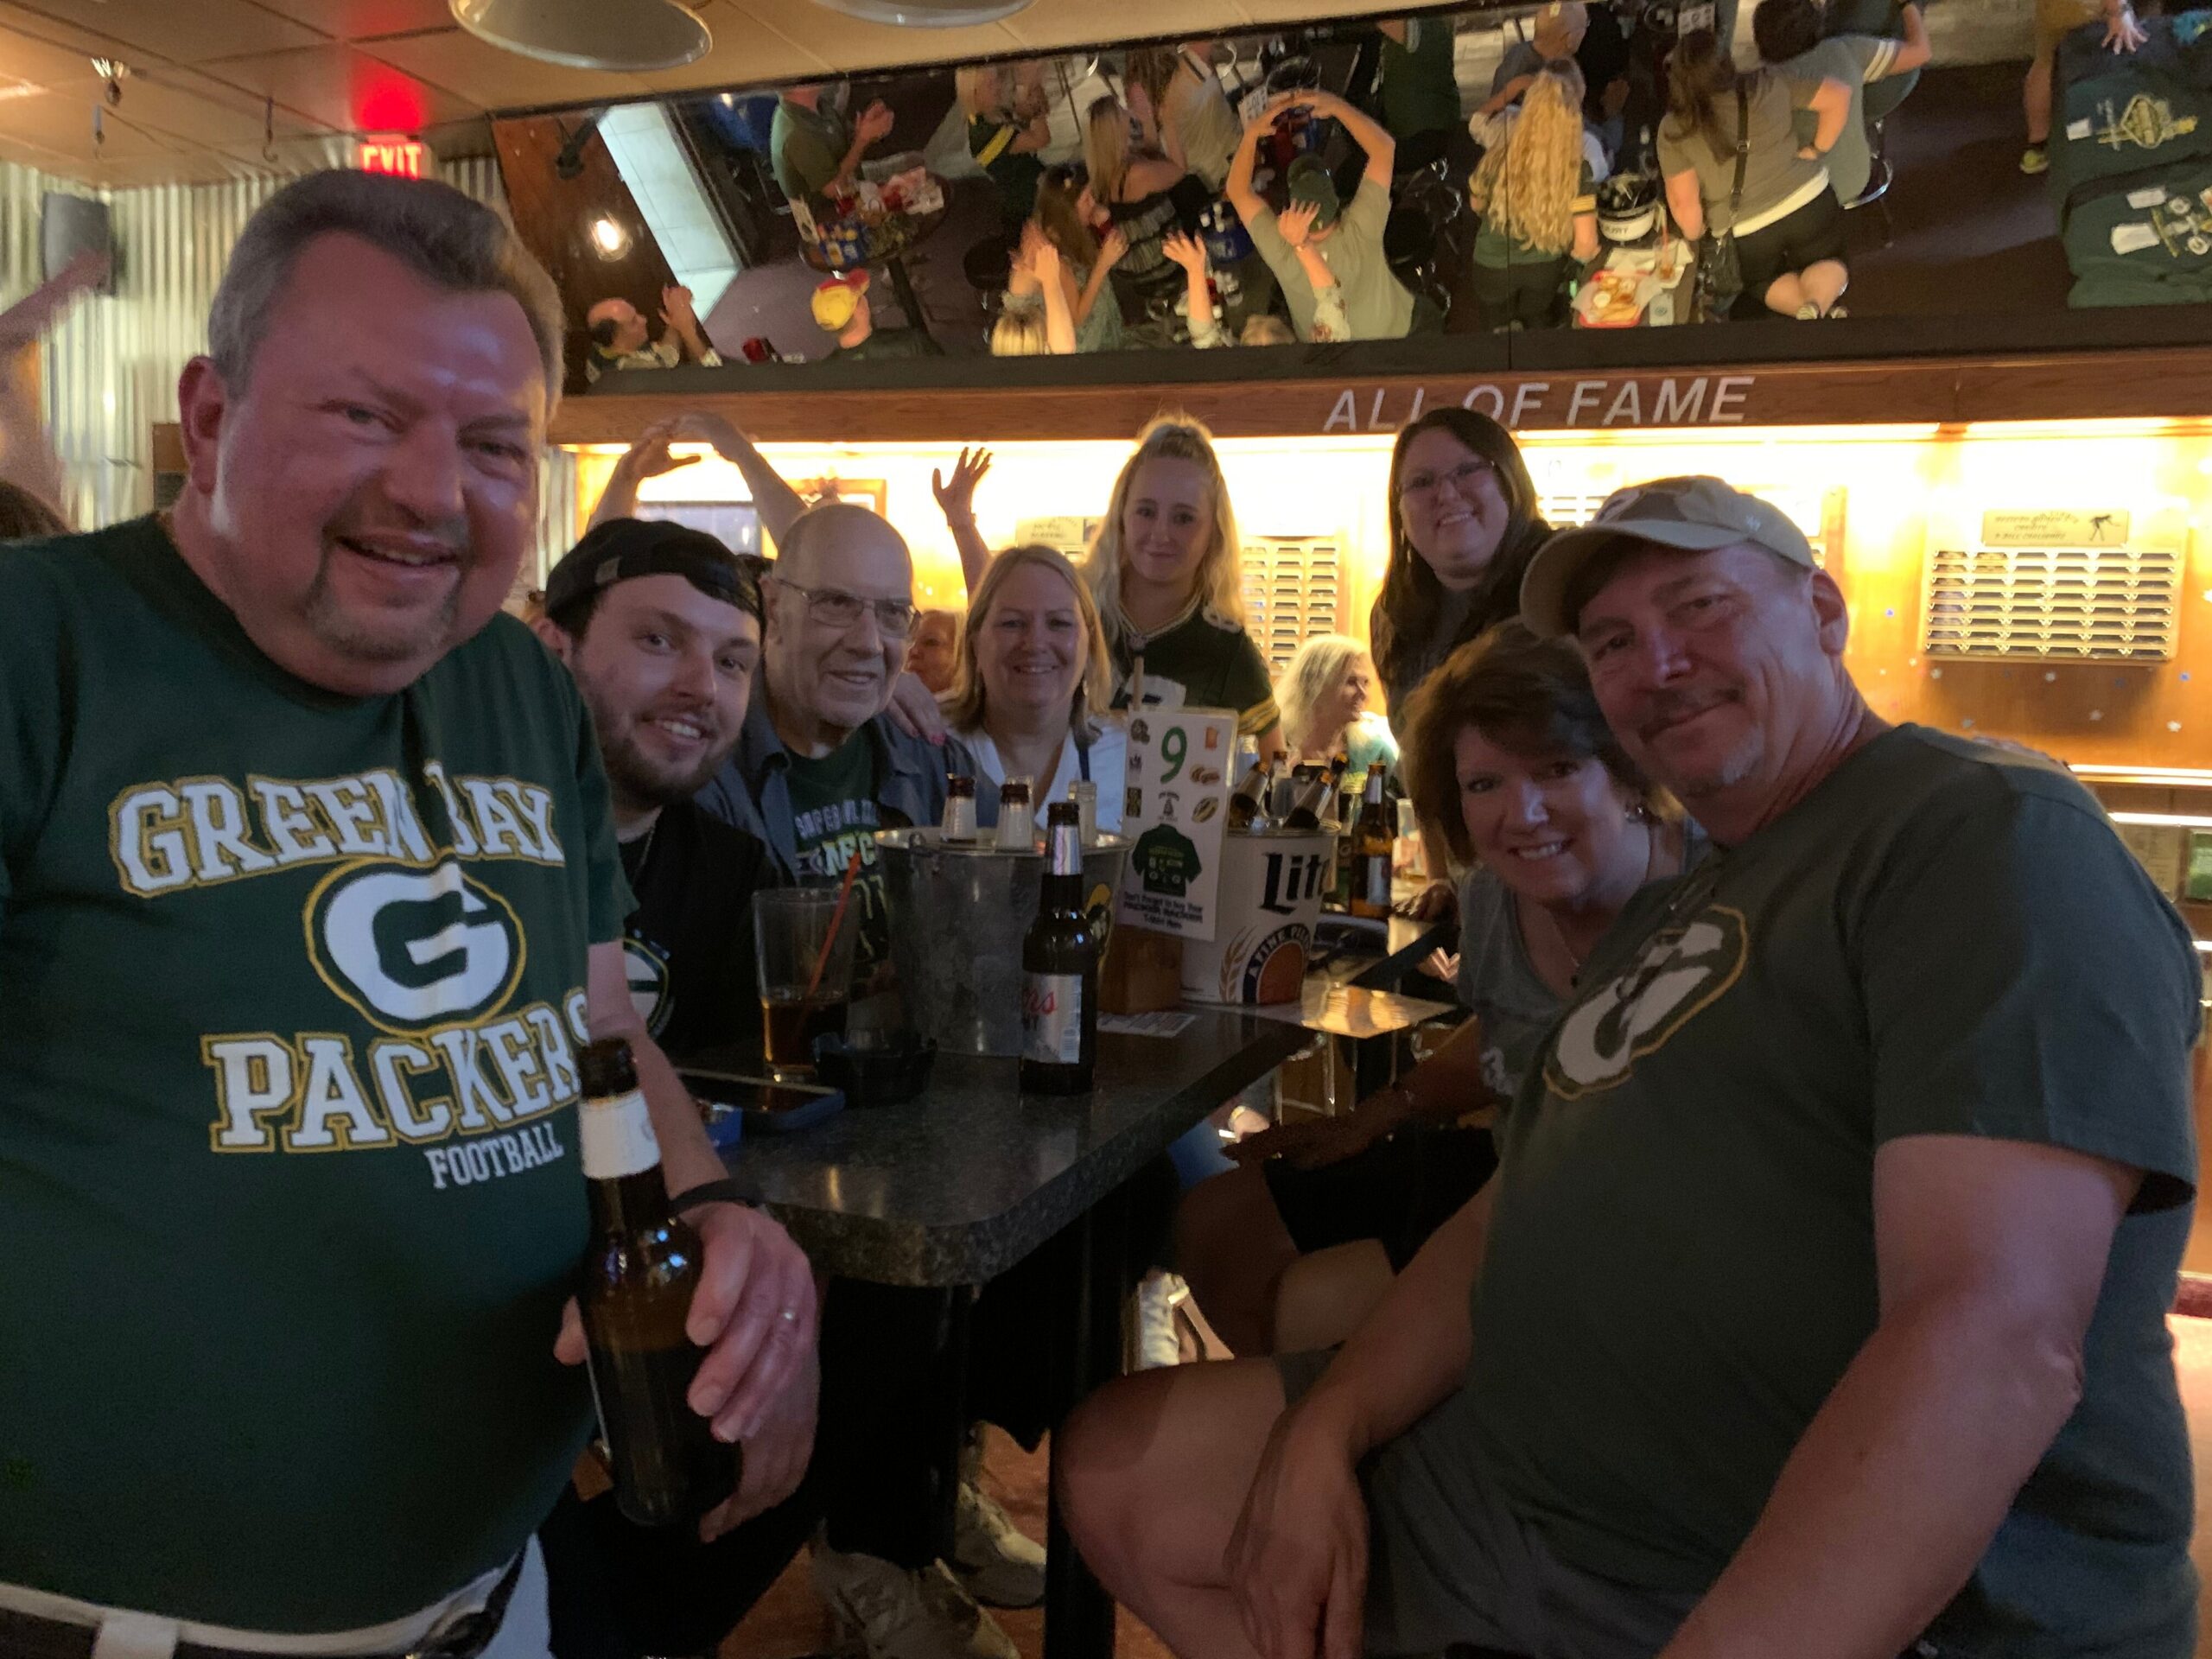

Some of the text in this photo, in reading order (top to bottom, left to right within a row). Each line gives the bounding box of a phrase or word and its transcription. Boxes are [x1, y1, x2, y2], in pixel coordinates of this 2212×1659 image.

[362, 144, 421, 179] EXIT
[1463, 383, 1550, 428] OF
[1567, 376, 1755, 426] FAME
[1160, 727, 1187, 785] 9
[109, 768, 435, 897] GREEN
[323, 863, 510, 1021] G
[424, 1122, 565, 1190] FOOTBALL
